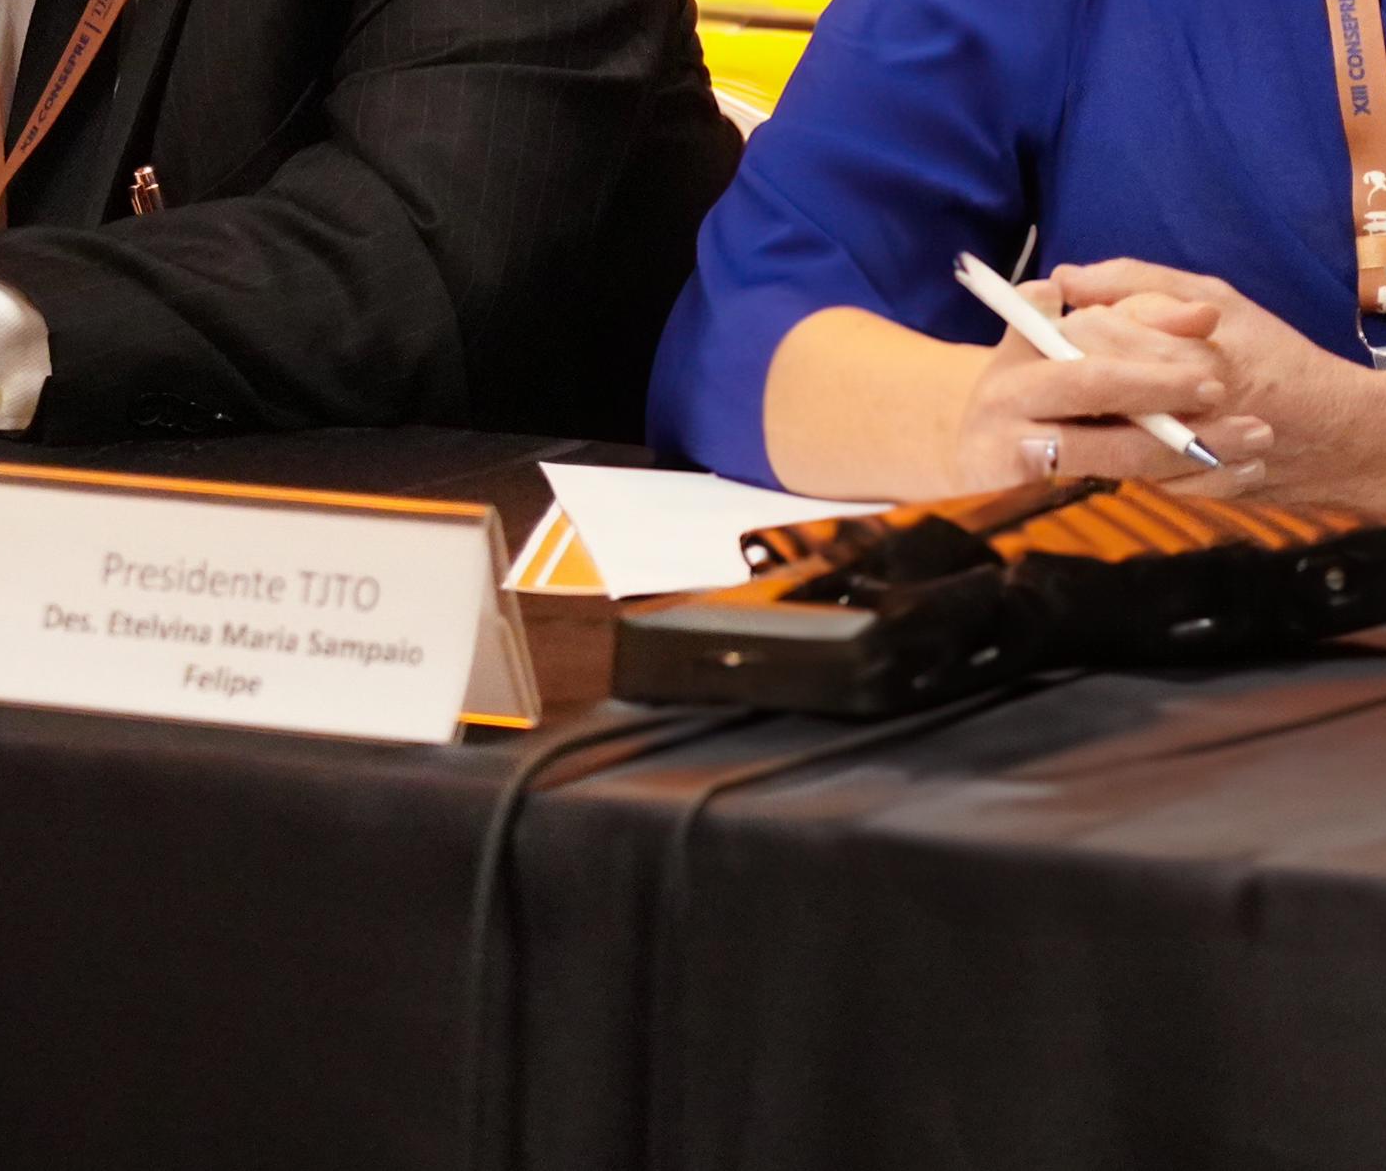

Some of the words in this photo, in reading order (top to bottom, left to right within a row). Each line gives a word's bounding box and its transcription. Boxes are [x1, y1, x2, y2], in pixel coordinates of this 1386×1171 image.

[37, 34, 90, 123] CONSEPRE
[1350, 84, 1371, 116] XIII
[102, 550, 287, 605] Presidente
[300, 570, 382, 613] TJTO
[43, 602, 96, 634] Des.
[108, 609, 212, 645] Etelvina
[221, 622, 300, 653] Maria
[308, 631, 424, 667] Sampaio
[182, 664, 263, 698] Felipe
